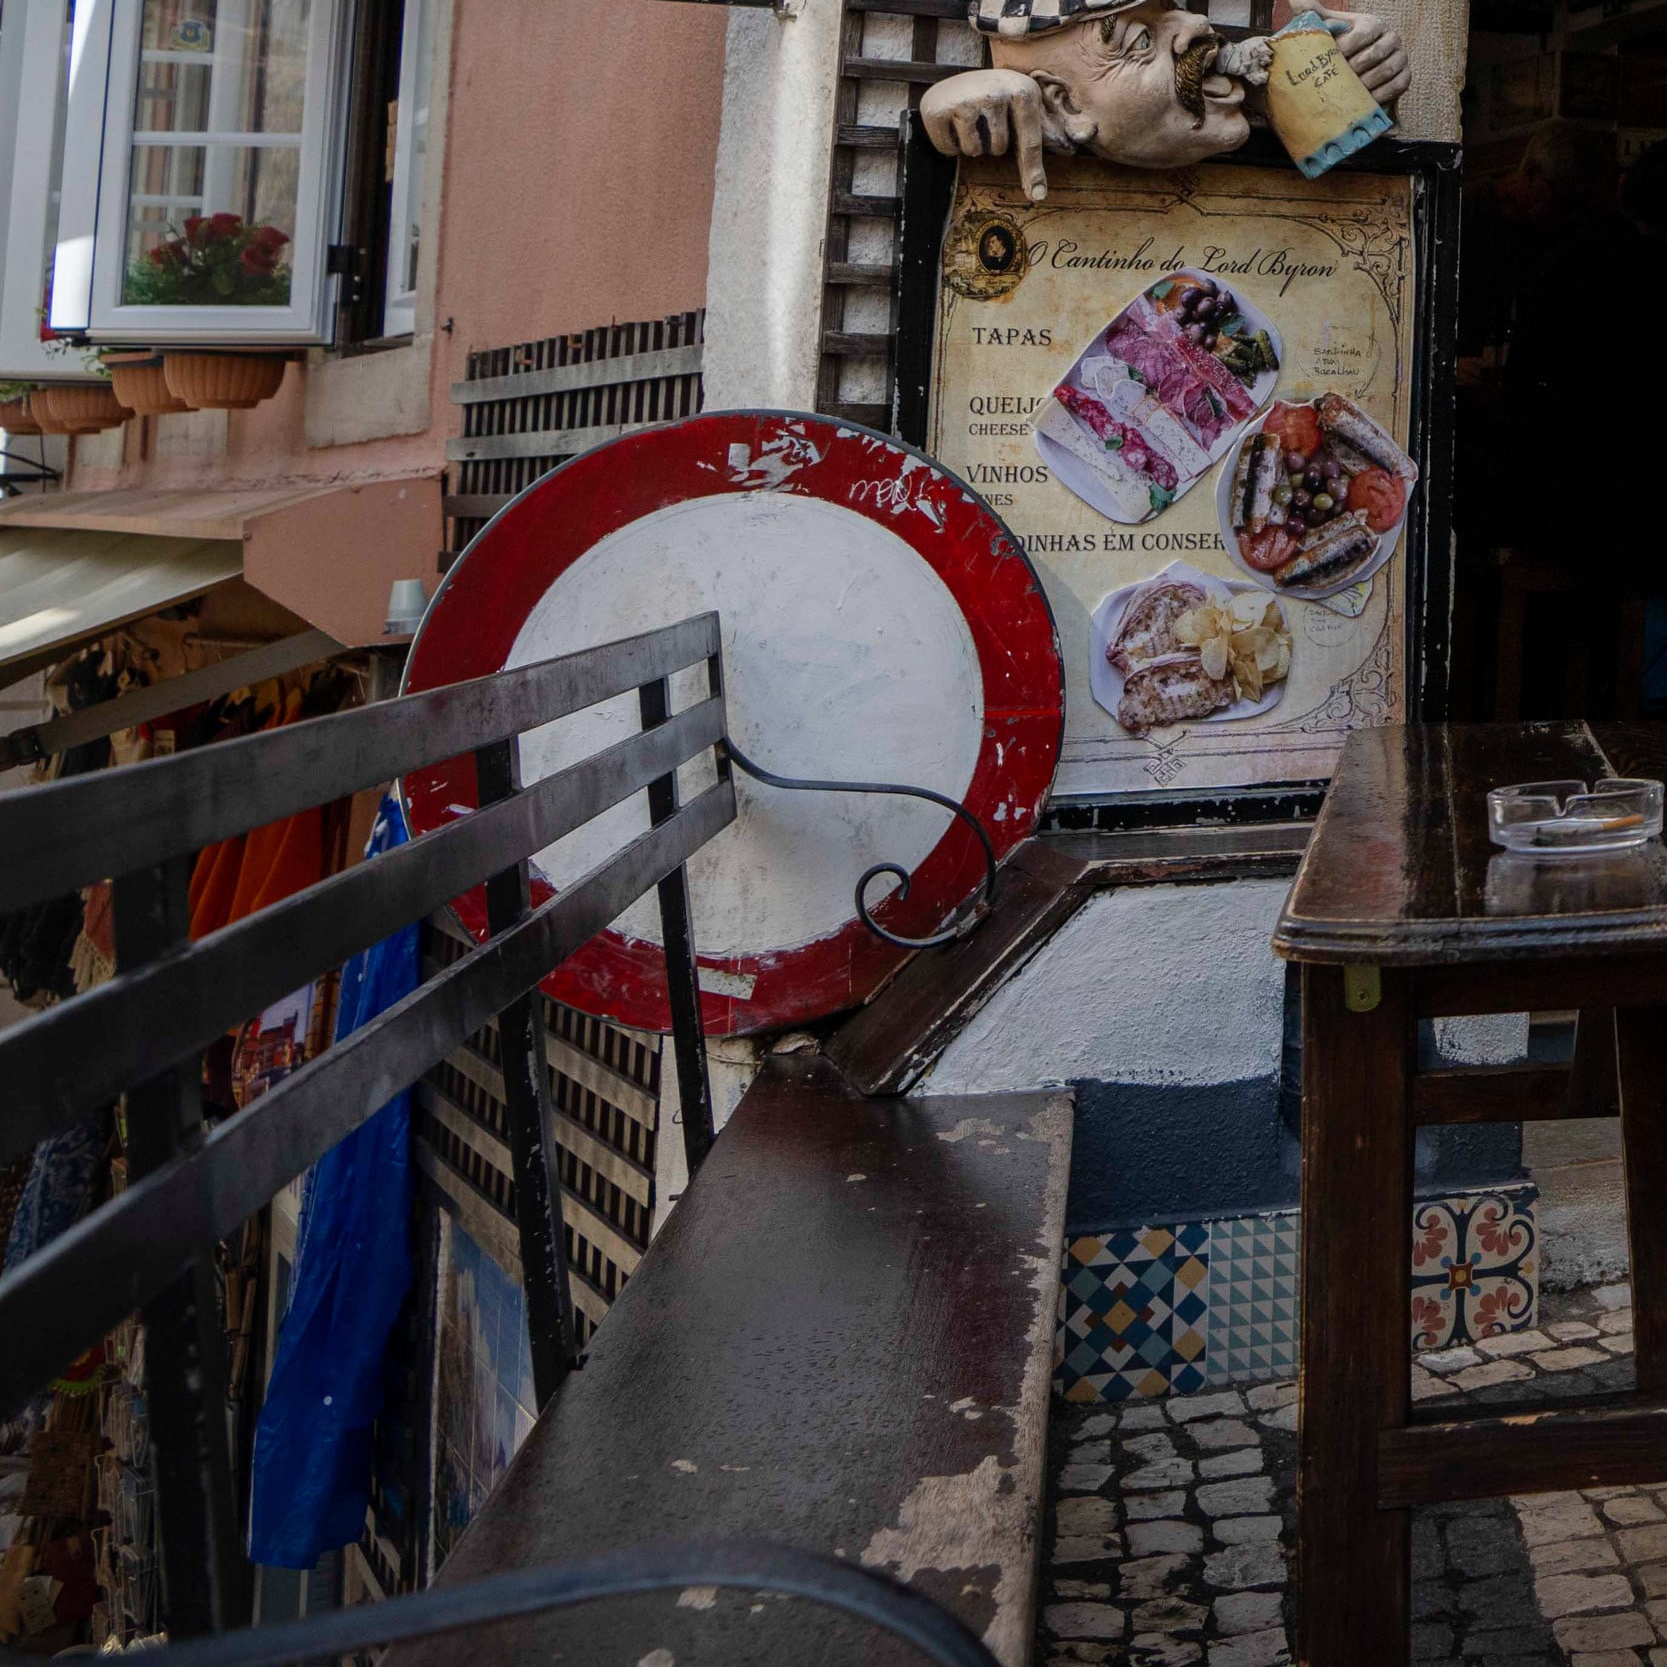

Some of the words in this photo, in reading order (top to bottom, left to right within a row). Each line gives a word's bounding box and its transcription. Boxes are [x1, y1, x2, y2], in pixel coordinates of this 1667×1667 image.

[1051, 236, 1156, 270] Cantinho
[1197, 246, 1262, 275] Lord
[1256, 247, 1337, 298] Byron
[972, 327, 1052, 347] TAPAS
[968, 423, 1028, 436] CHEESE
[965, 464, 1049, 484] VINHOS
[985, 493, 1014, 506] NES
[1013, 534, 1097, 553] DINHAS
[1103, 533, 1135, 552] EM
[1141, 533, 1226, 552] CONSER
